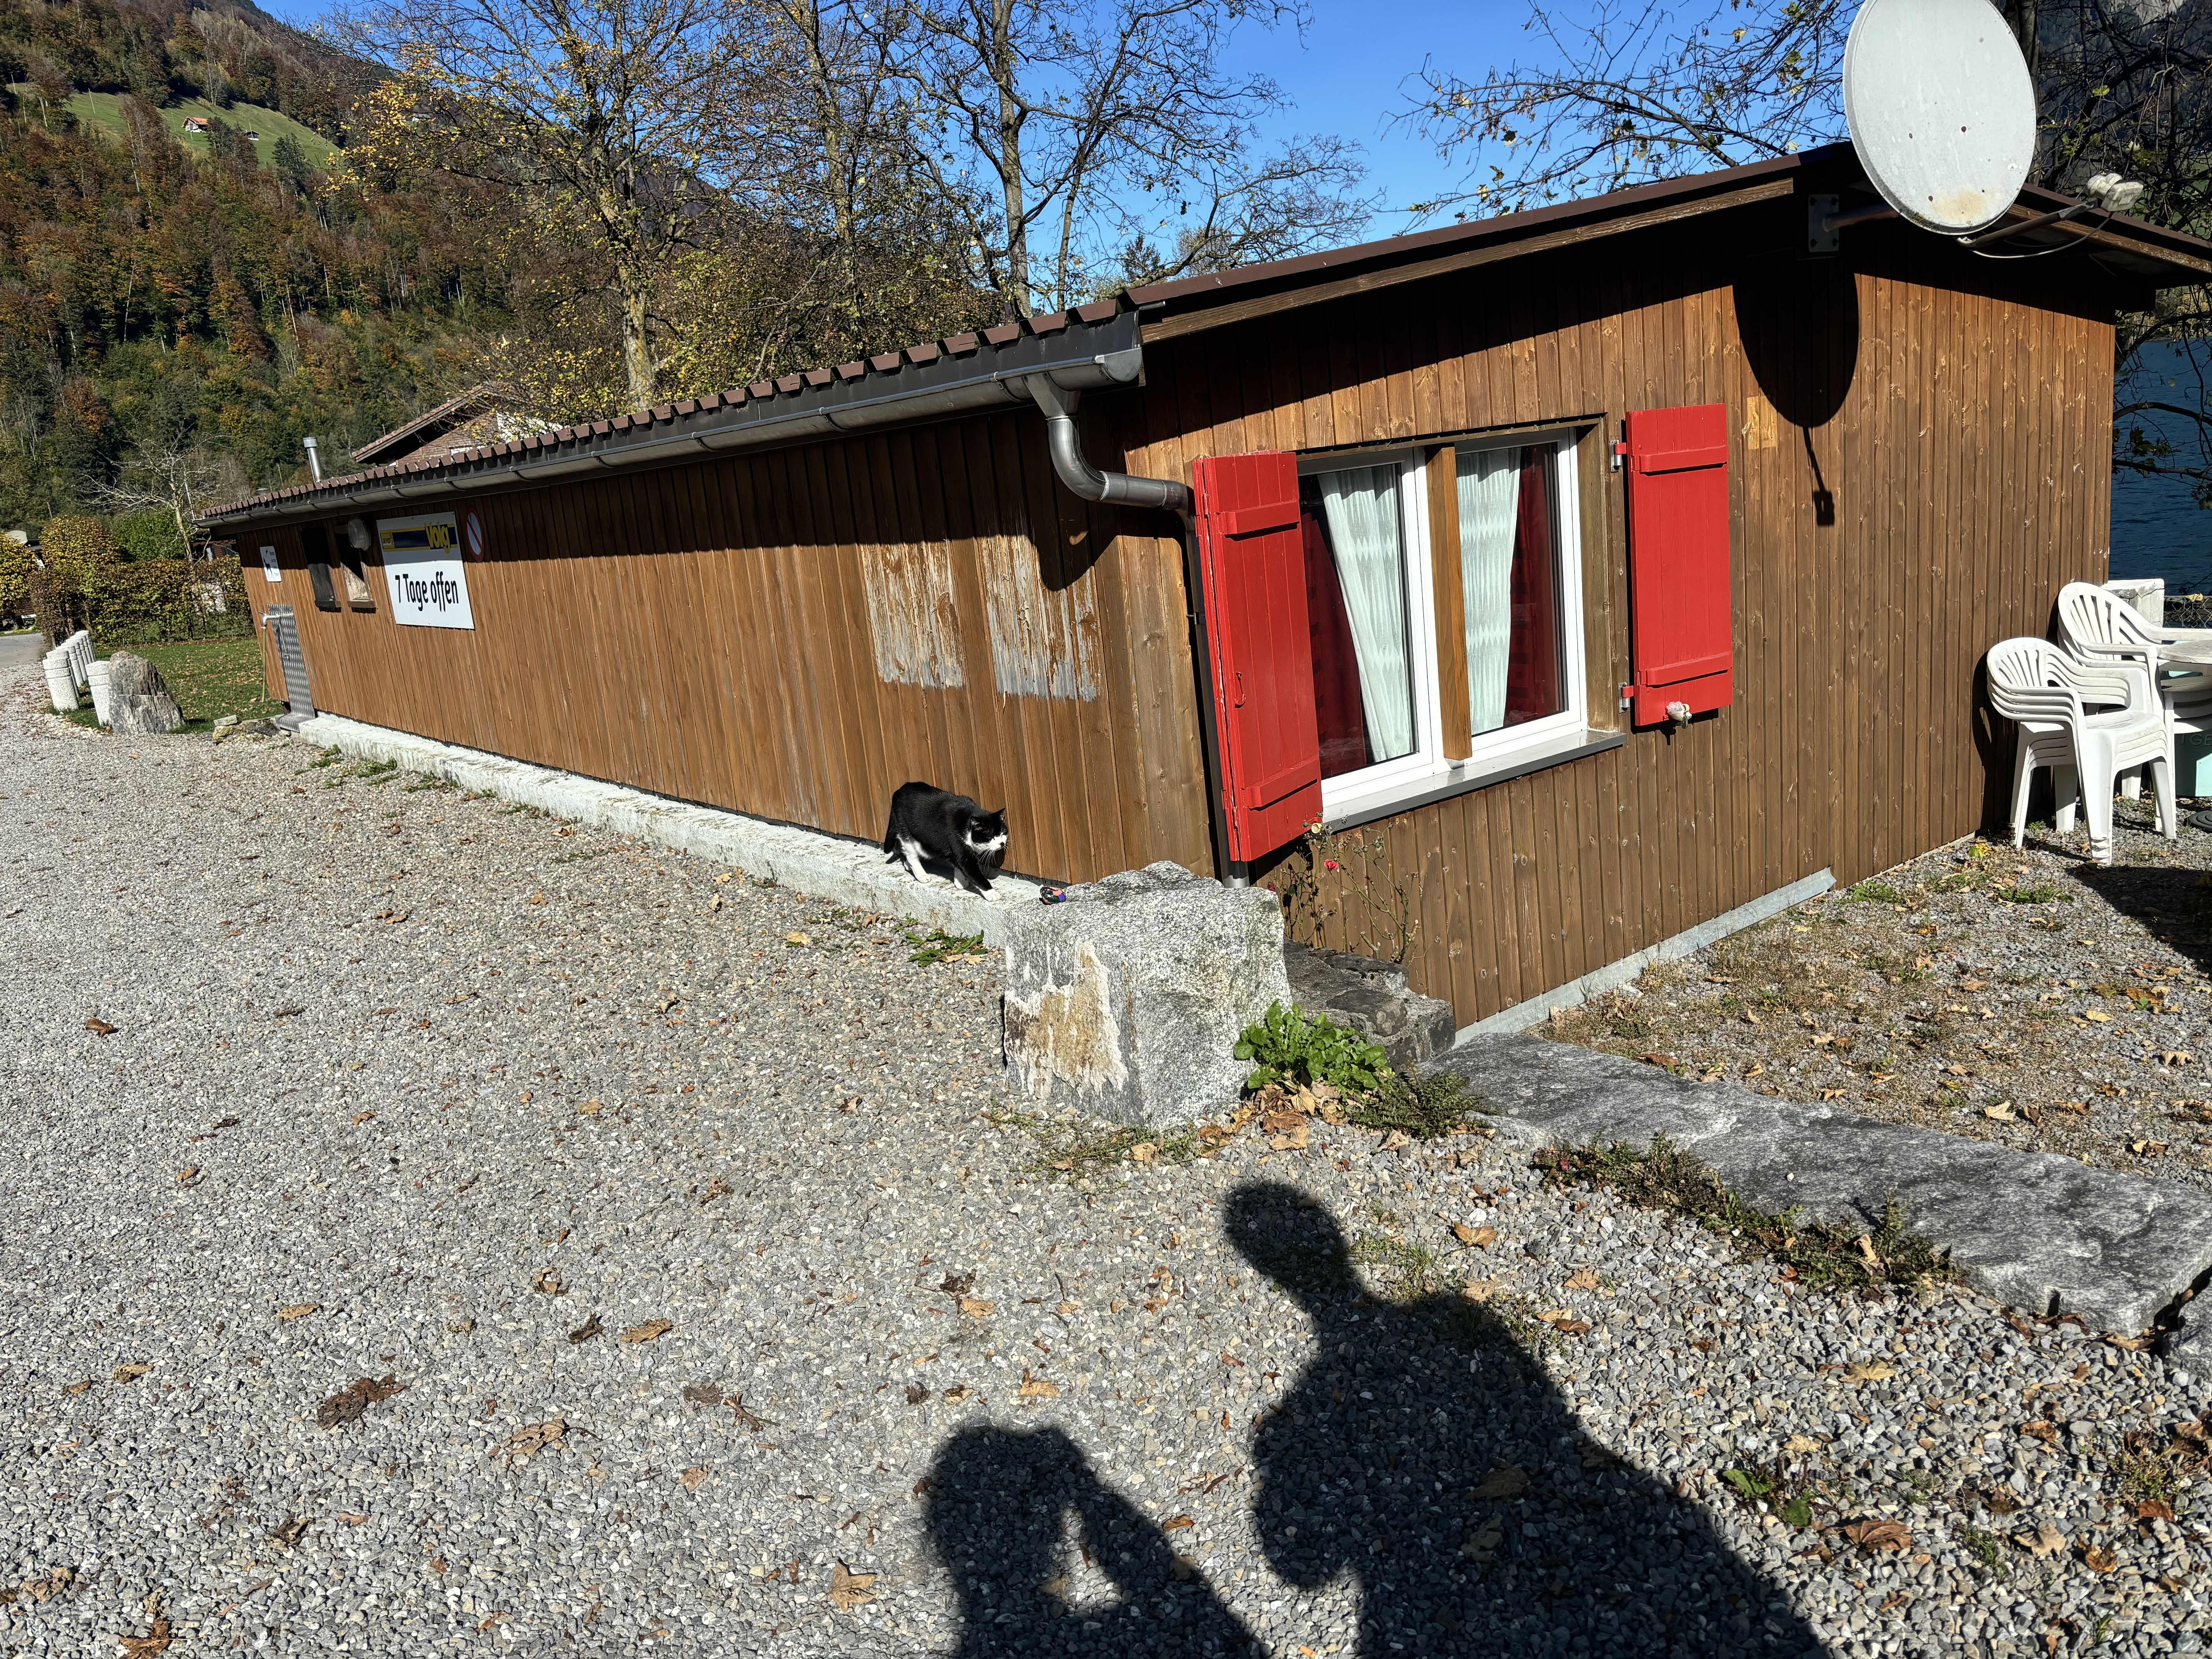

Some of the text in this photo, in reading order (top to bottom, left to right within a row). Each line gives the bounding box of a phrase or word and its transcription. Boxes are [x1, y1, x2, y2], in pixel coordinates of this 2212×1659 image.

[425, 521, 451, 554] Volg
[395, 571, 459, 612] 7 Tage offen
